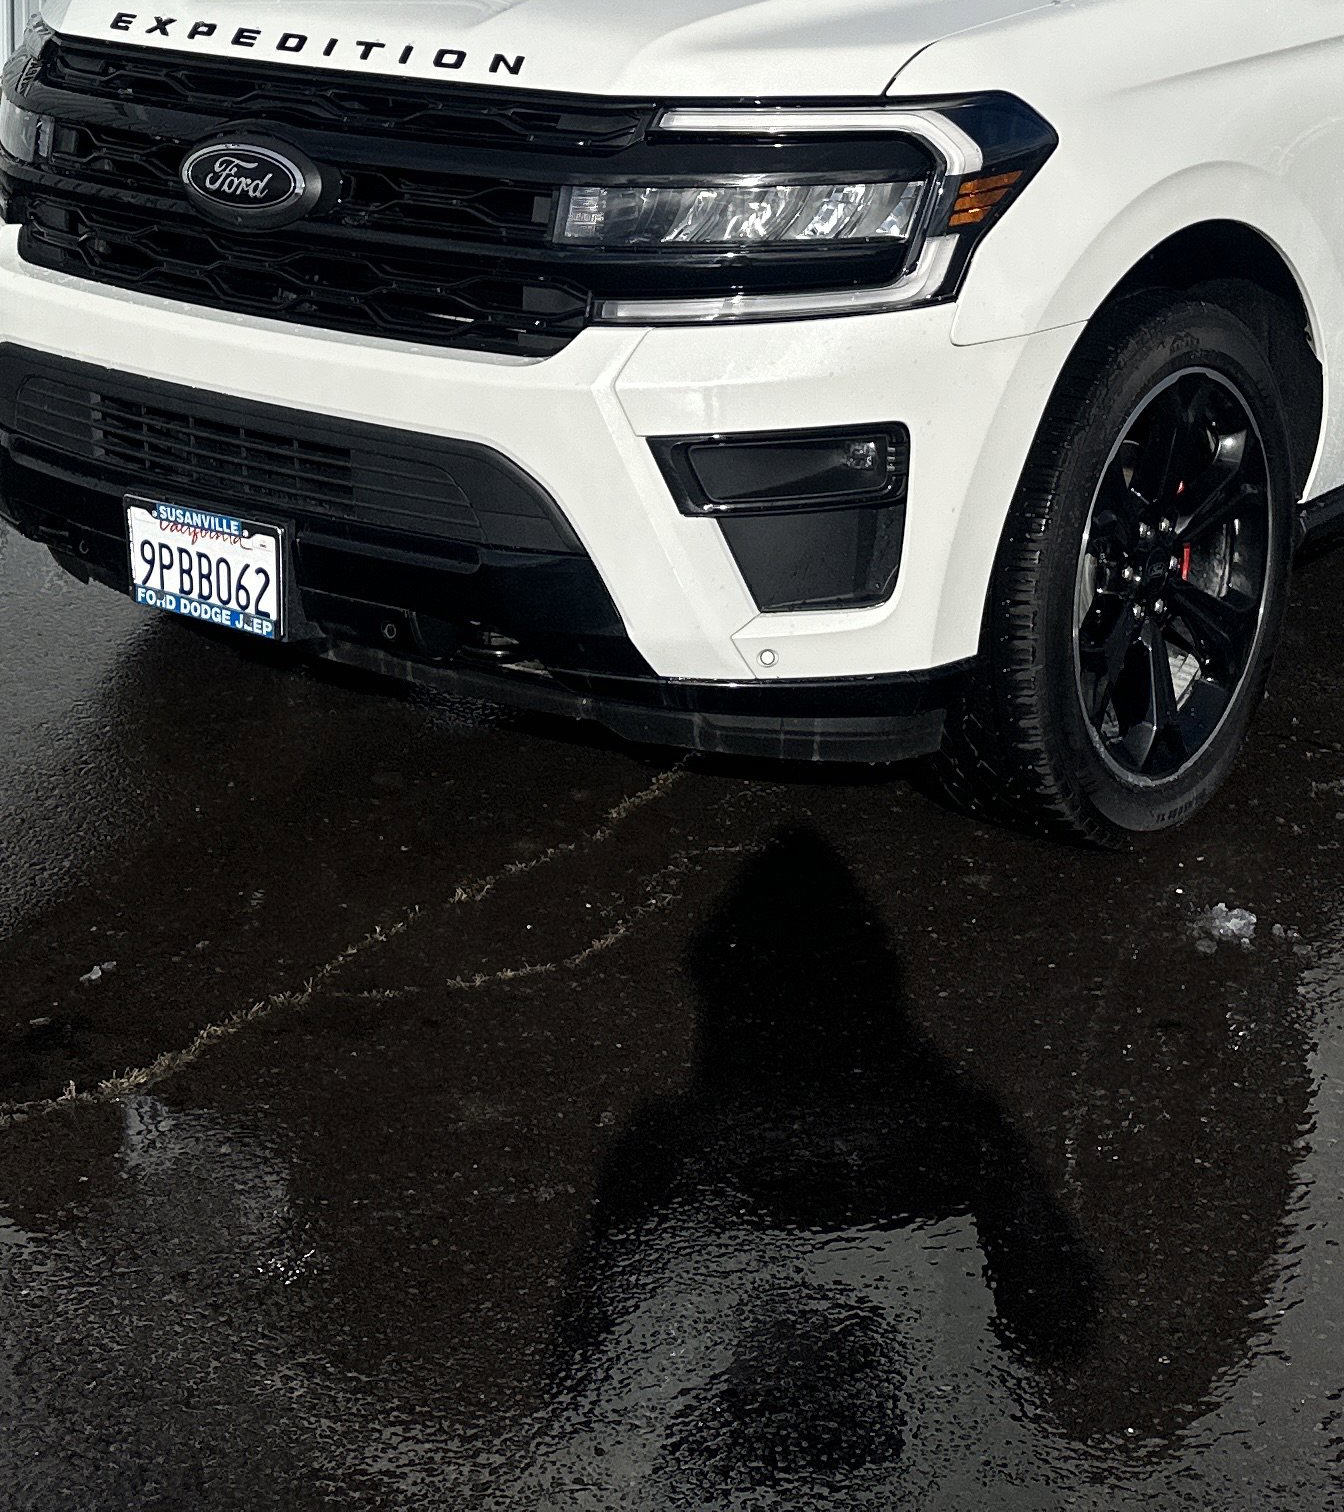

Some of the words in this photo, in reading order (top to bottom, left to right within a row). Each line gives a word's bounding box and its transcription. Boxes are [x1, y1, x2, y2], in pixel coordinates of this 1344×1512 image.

[110, 11, 525, 75] EXPEDITION
[205, 156, 272, 200] Ford
[159, 505, 240, 534] SUSANVILLE
[140, 539, 271, 618] 9PBB062
[180, 598, 231, 625] DODGE
